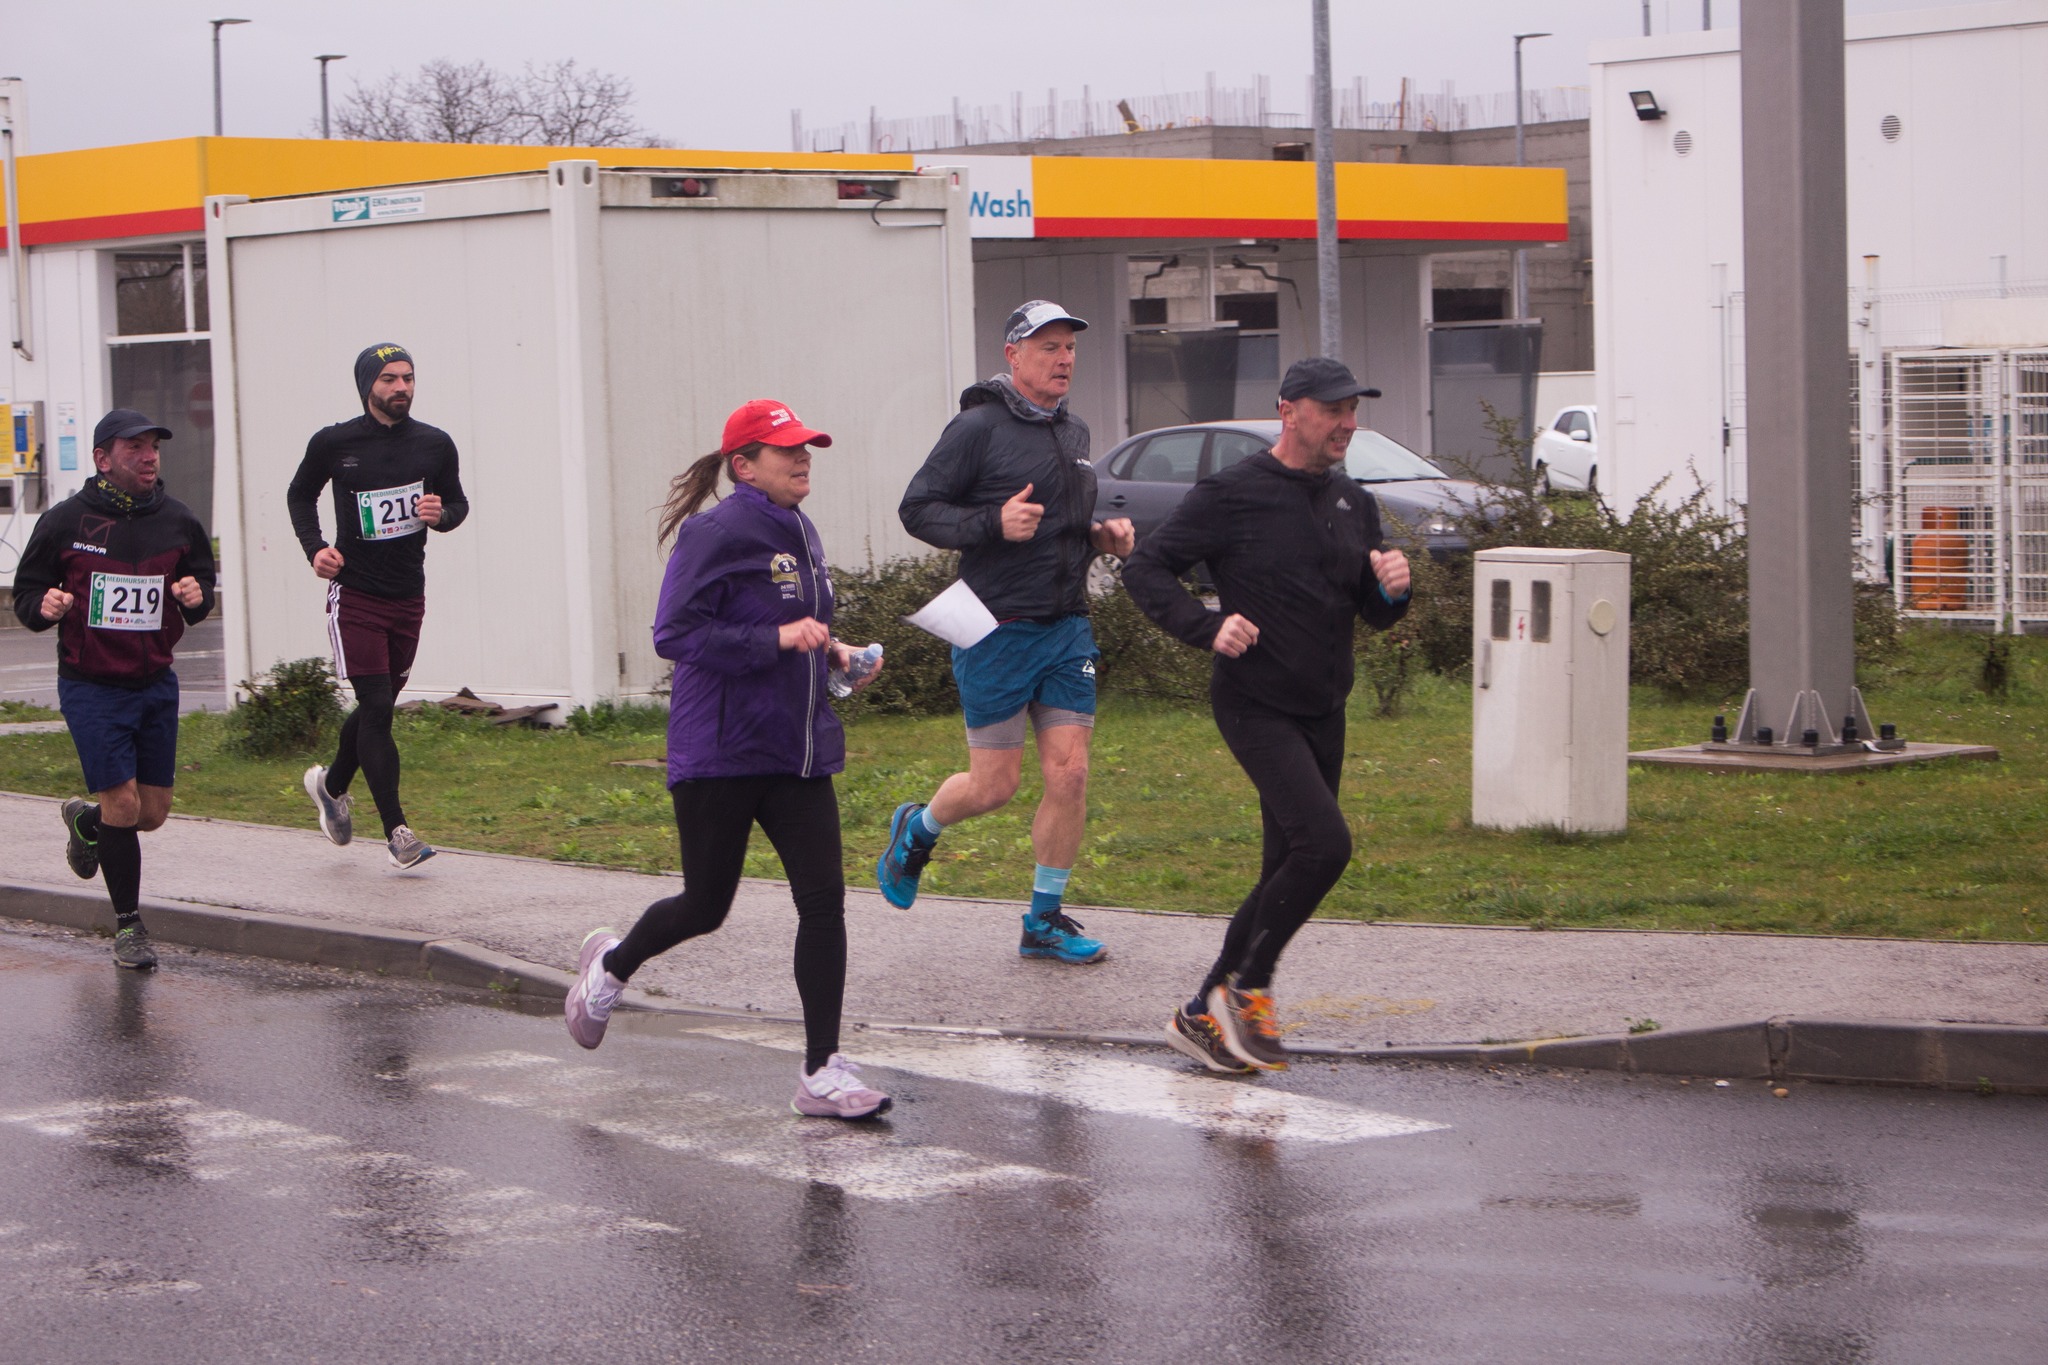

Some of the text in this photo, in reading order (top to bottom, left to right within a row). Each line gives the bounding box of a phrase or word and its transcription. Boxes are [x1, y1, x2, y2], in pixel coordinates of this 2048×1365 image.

[372, 197, 388, 207] EKO
[969, 189, 1031, 217] Wash
[360, 493, 371, 508] 6
[379, 493, 421, 525] 218
[73, 541, 107, 555] GIVOVA
[94, 574, 105, 590] 6
[111, 586, 160, 615] 219
